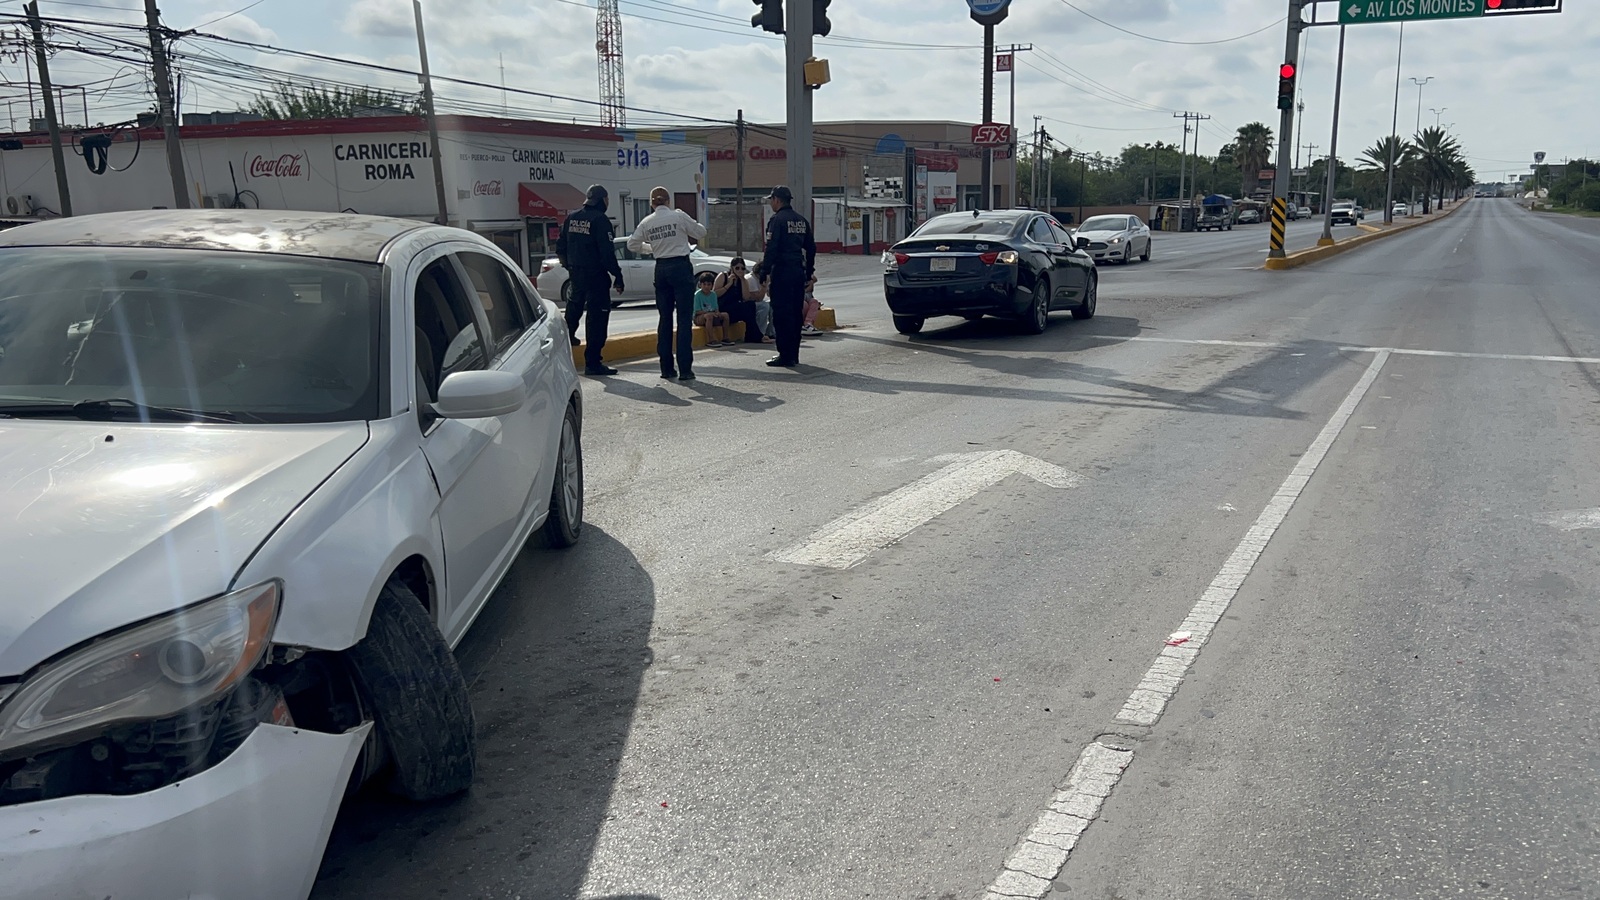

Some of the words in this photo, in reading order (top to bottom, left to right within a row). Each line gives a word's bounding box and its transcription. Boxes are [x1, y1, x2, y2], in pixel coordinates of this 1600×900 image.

[1365, 2, 1385, 18] AV.
[1389, 0, 1415, 17] LOS
[1419, 0, 1476, 15] MONTES
[998, 56, 1009, 66] 24
[335, 142, 440, 161] CARNICERI
[512, 149, 566, 165] CARNICERIA
[250, 153, 303, 178] Coca-Cola
[365, 163, 415, 180] ROMA
[529, 167, 555, 181] ROMA
